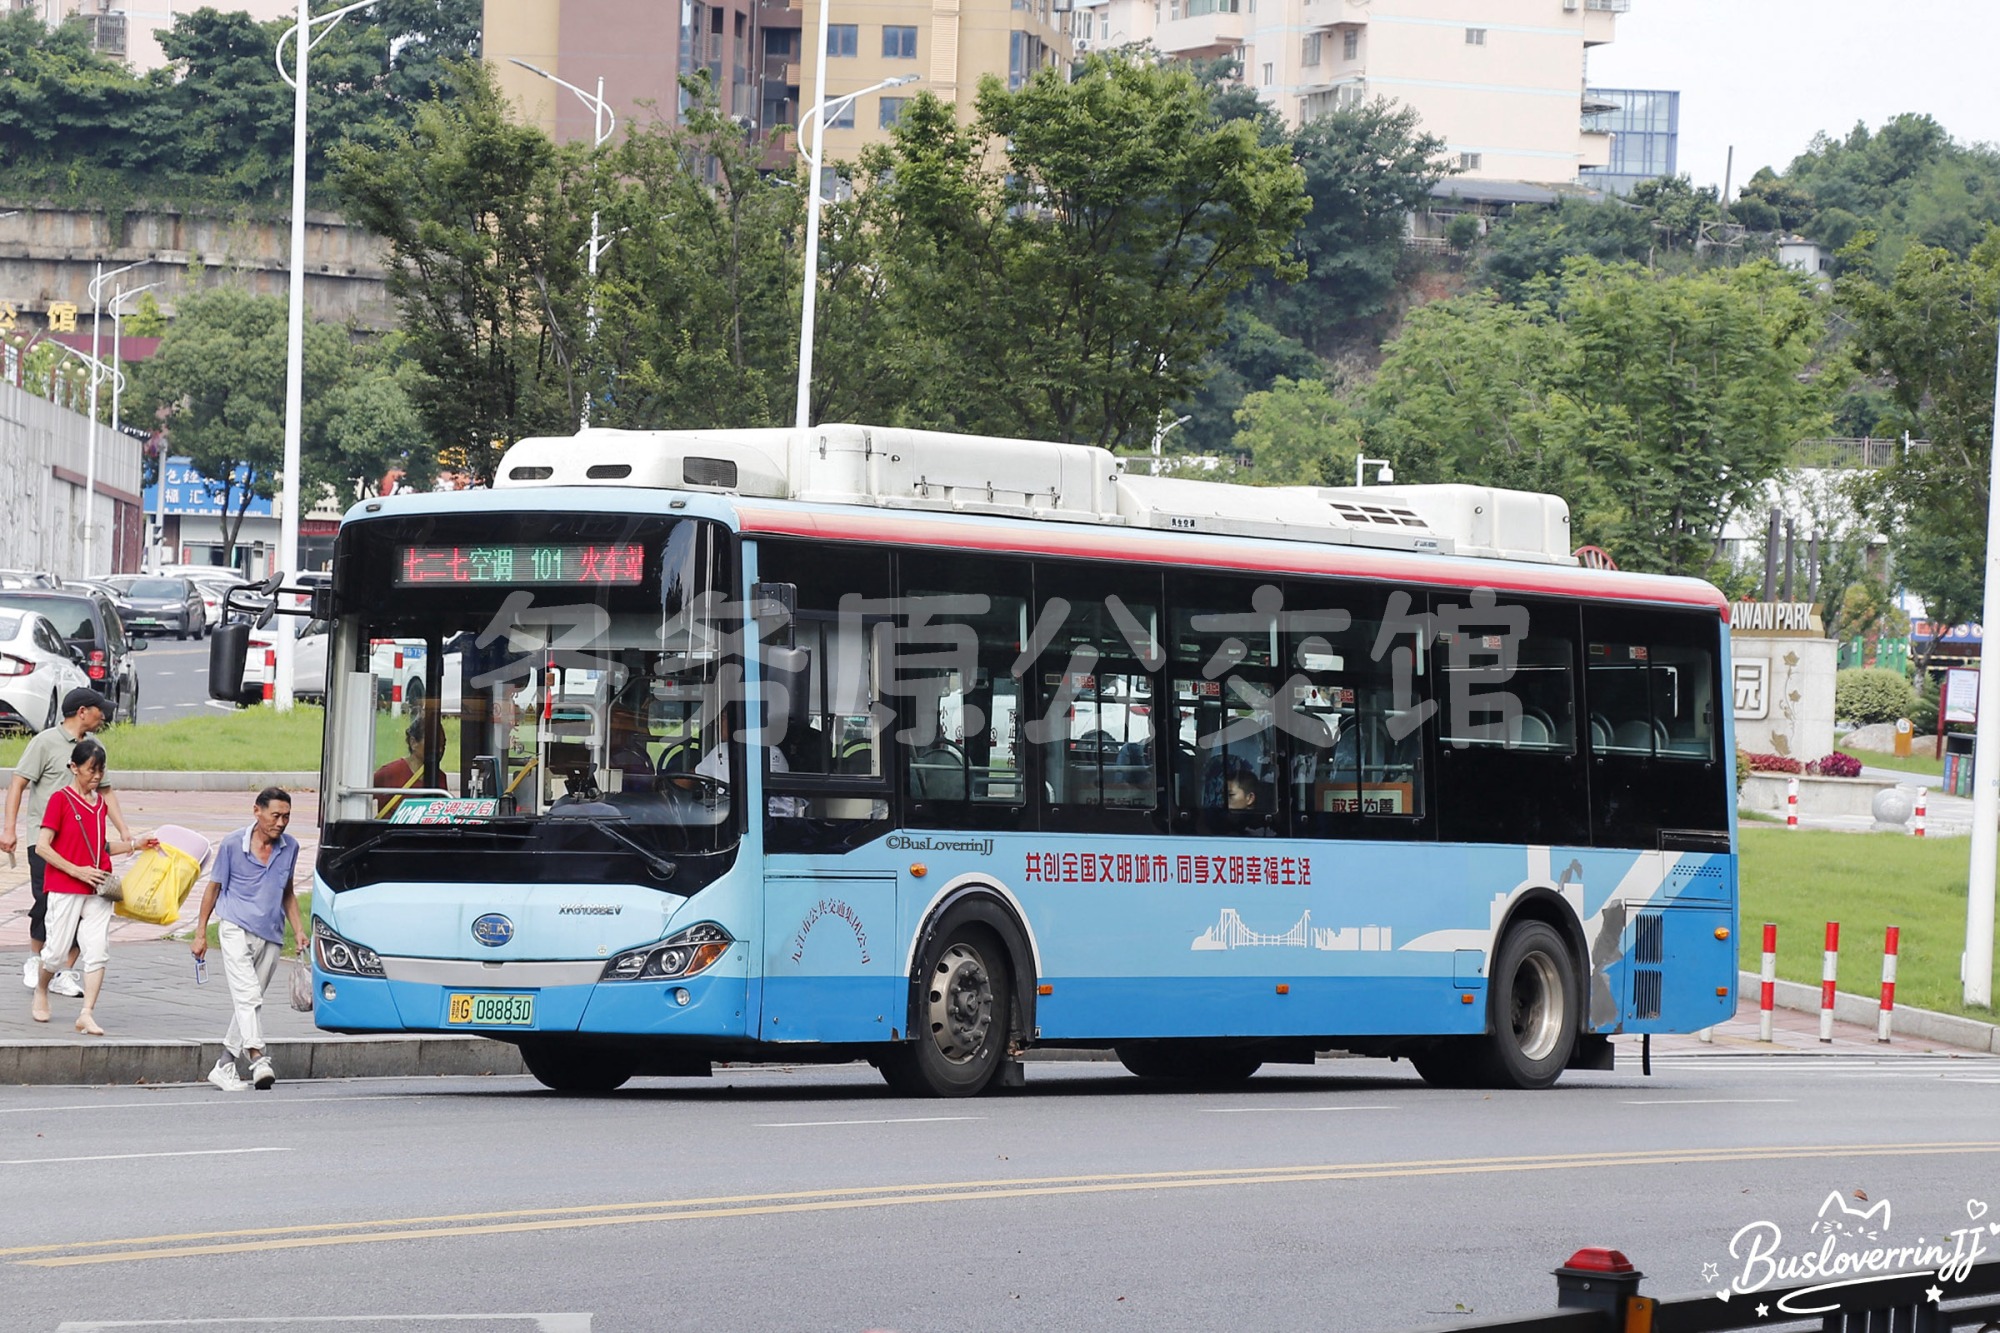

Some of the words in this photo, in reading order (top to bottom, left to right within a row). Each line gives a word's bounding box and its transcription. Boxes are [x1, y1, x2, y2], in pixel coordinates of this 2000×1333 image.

[531, 548, 562, 581] 101
[1775, 602, 1814, 631] PARK
[427, 801, 496, 816] 空调开启
[476, 1000, 531, 1020] 08883D
